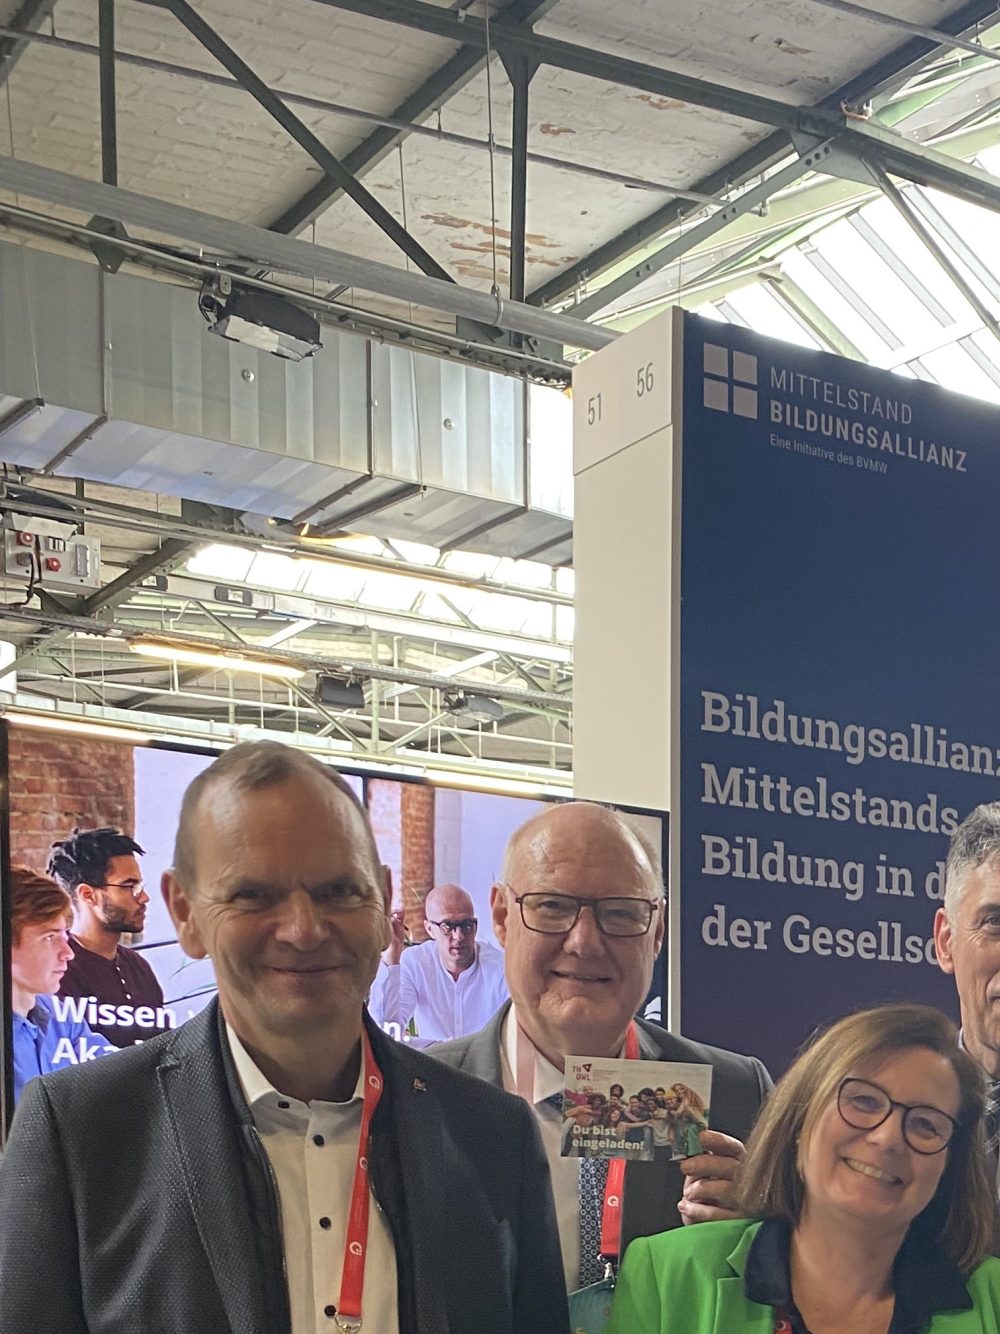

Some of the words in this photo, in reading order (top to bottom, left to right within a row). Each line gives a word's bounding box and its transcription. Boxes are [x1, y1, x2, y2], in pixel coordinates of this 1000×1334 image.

[637, 362, 653, 398] 56
[770, 366, 912, 425] MITTELSTAND
[588, 392, 601, 426] 51
[770, 399, 967, 472] BILDUNGSALLIANZ
[770, 433, 791, 450] Eine
[793, 439, 834, 461] Initiative
[837, 451, 854, 466] des
[856, 455, 888, 474] BVMW
[701, 763, 959, 837] Mittelstands
[701, 835, 864, 901] Bildung
[877, 854, 914, 898] in
[702, 905, 770, 950] der
[783, 913, 937, 966] Gesellsc
[52, 995, 177, 1029] Wissen
[572, 1124, 589, 1135] Du
[591, 1124, 617, 1136] bist
[572, 1138, 645, 1151] eingeladen!
